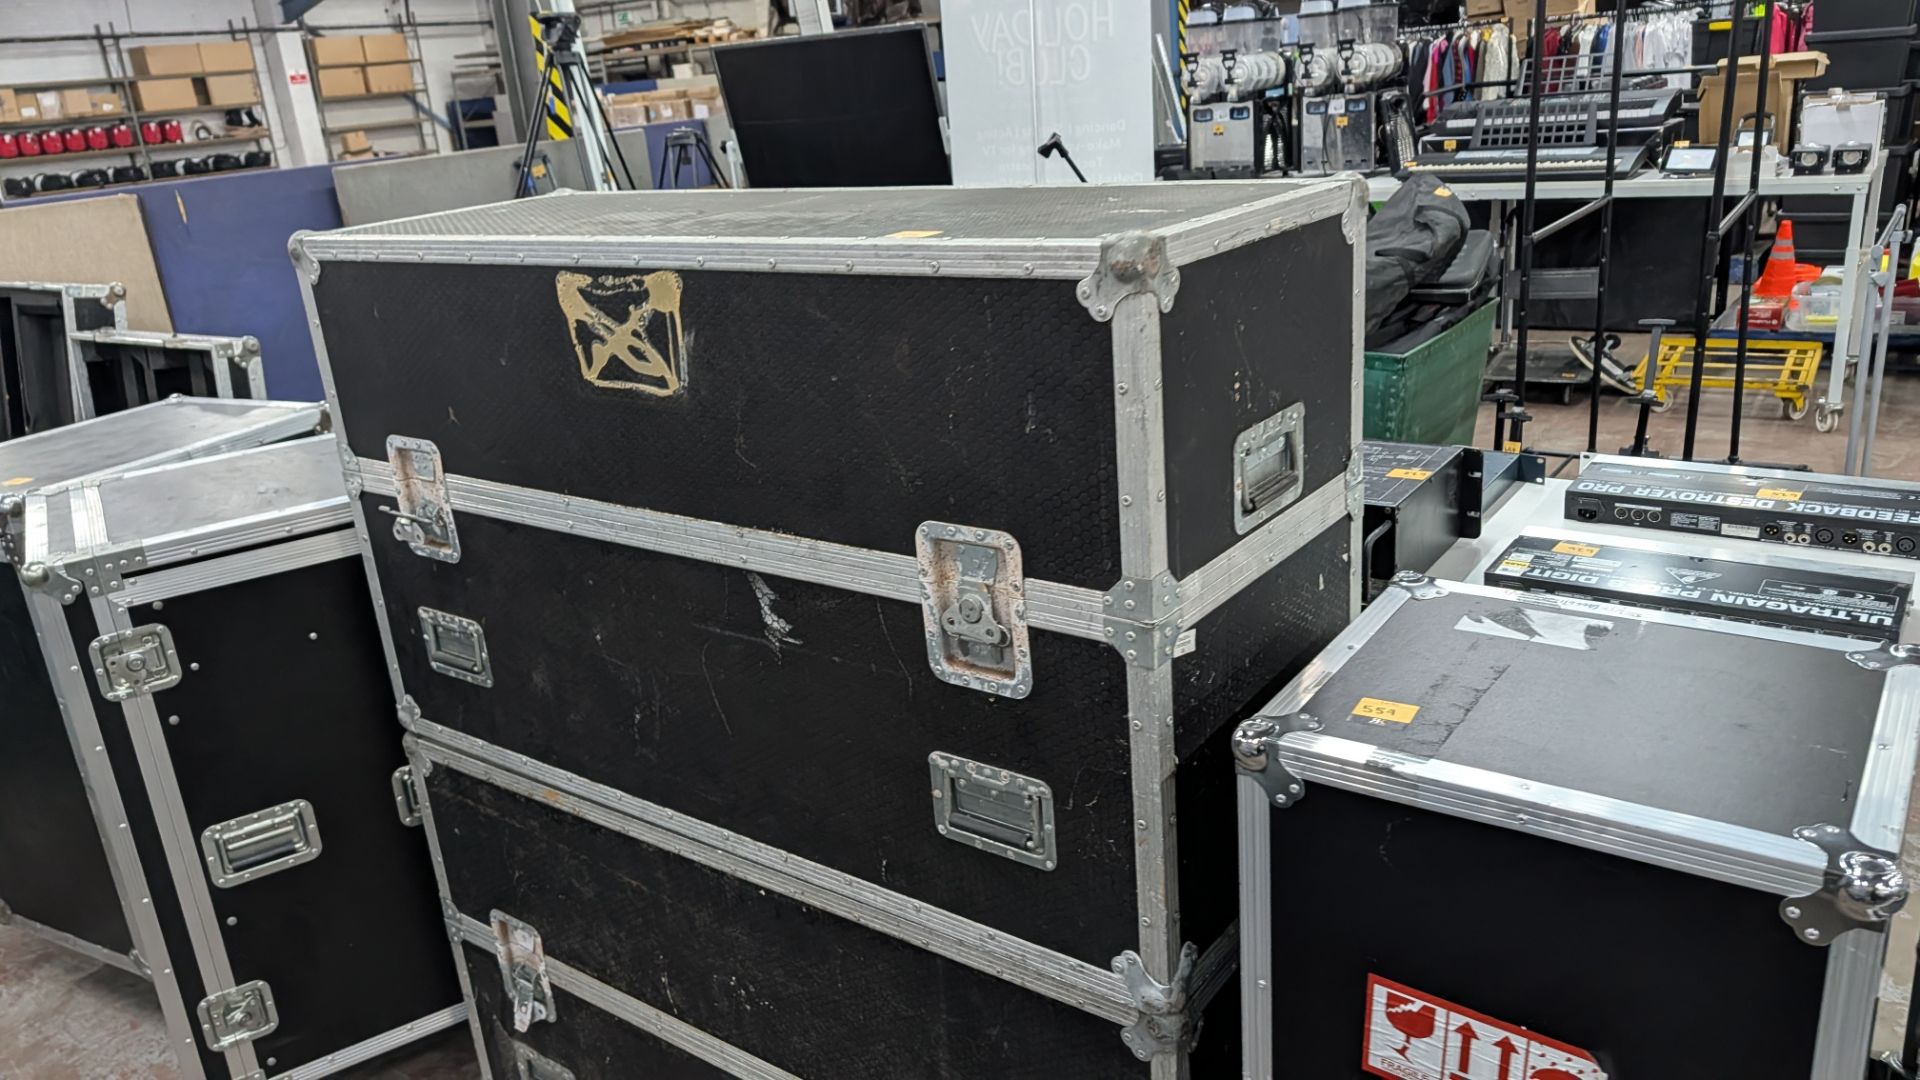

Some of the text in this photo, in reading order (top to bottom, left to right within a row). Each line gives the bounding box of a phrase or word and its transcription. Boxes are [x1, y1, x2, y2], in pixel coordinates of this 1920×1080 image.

[1577, 481, 1625, 494] PRO
[1633, 487, 1776, 509] DESTROYER
[1709, 592, 1894, 626] ULTRAGAIN
[1362, 704, 1397, 716] 554
[1381, 1058, 1430, 1080] FRAGILE
